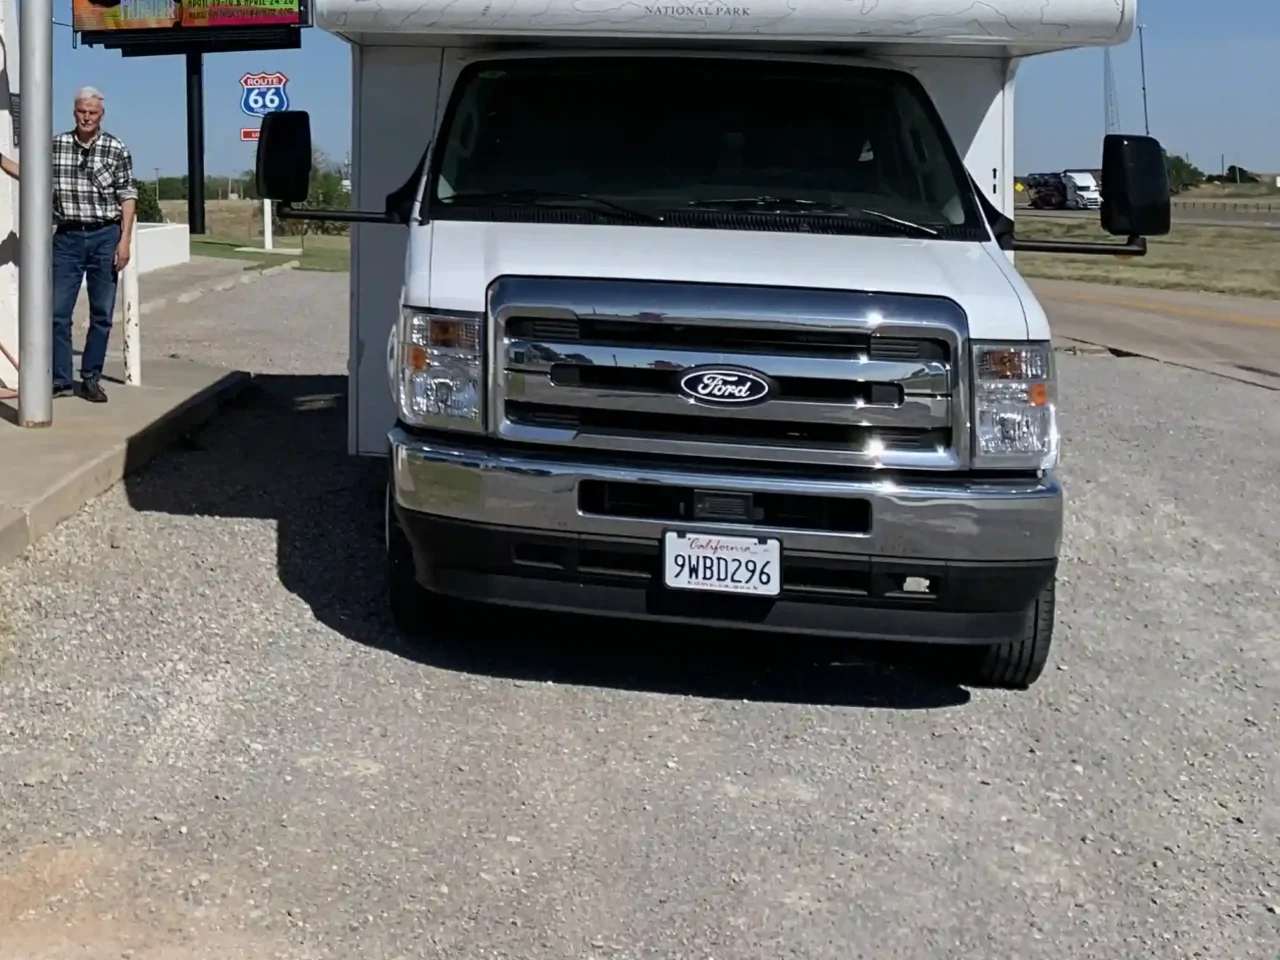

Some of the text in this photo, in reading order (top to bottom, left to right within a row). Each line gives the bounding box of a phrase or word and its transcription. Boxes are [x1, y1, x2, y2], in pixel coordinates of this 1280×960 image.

[188, 0, 208, 9] APRIL
[644, 5, 751, 17] NATIONAL PARK
[247, 78, 280, 86] ROUTE
[248, 88, 280, 109] 66
[698, 374, 752, 397] Ford
[689, 538, 758, 554] California
[674, 554, 771, 586] 9WBD296
